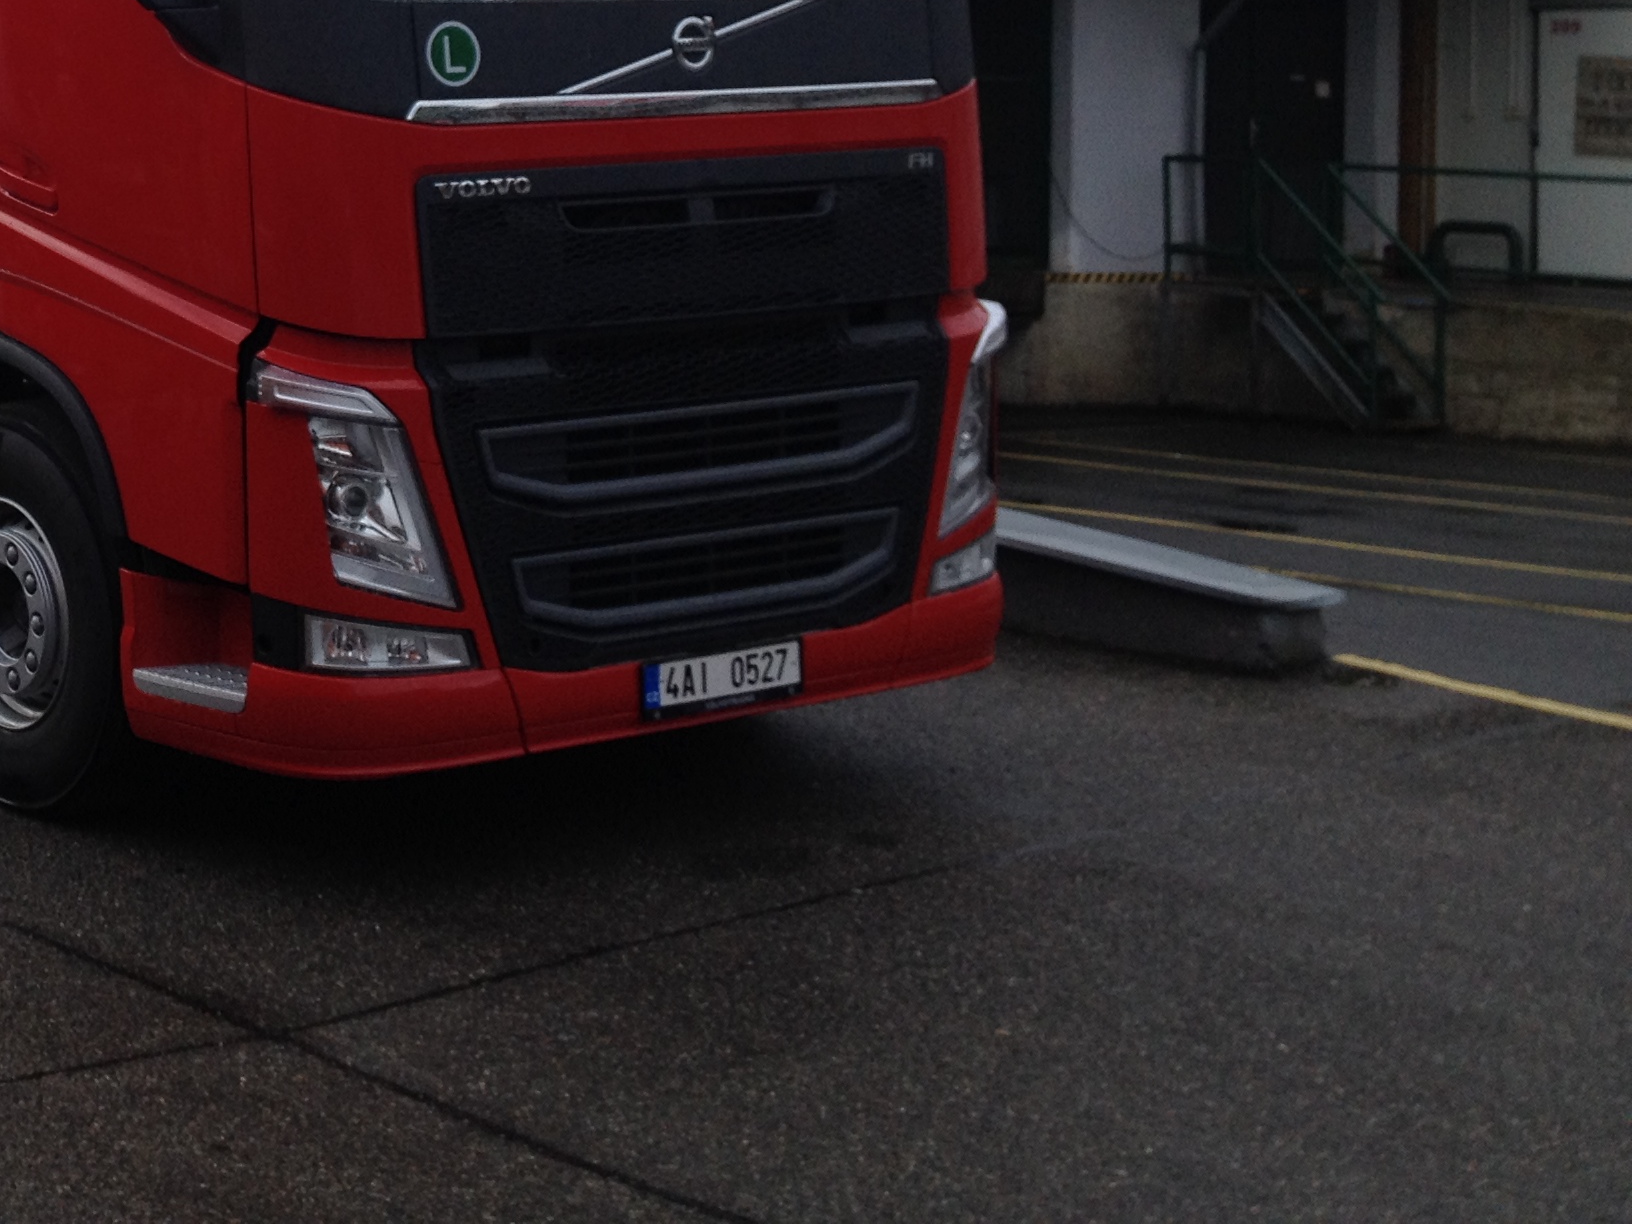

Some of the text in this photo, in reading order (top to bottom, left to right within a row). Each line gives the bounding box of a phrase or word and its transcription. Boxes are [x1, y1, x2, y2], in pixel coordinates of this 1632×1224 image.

[443, 36, 467, 73] L
[434, 176, 532, 200] VOLVO
[731, 648, 788, 688] 0527
